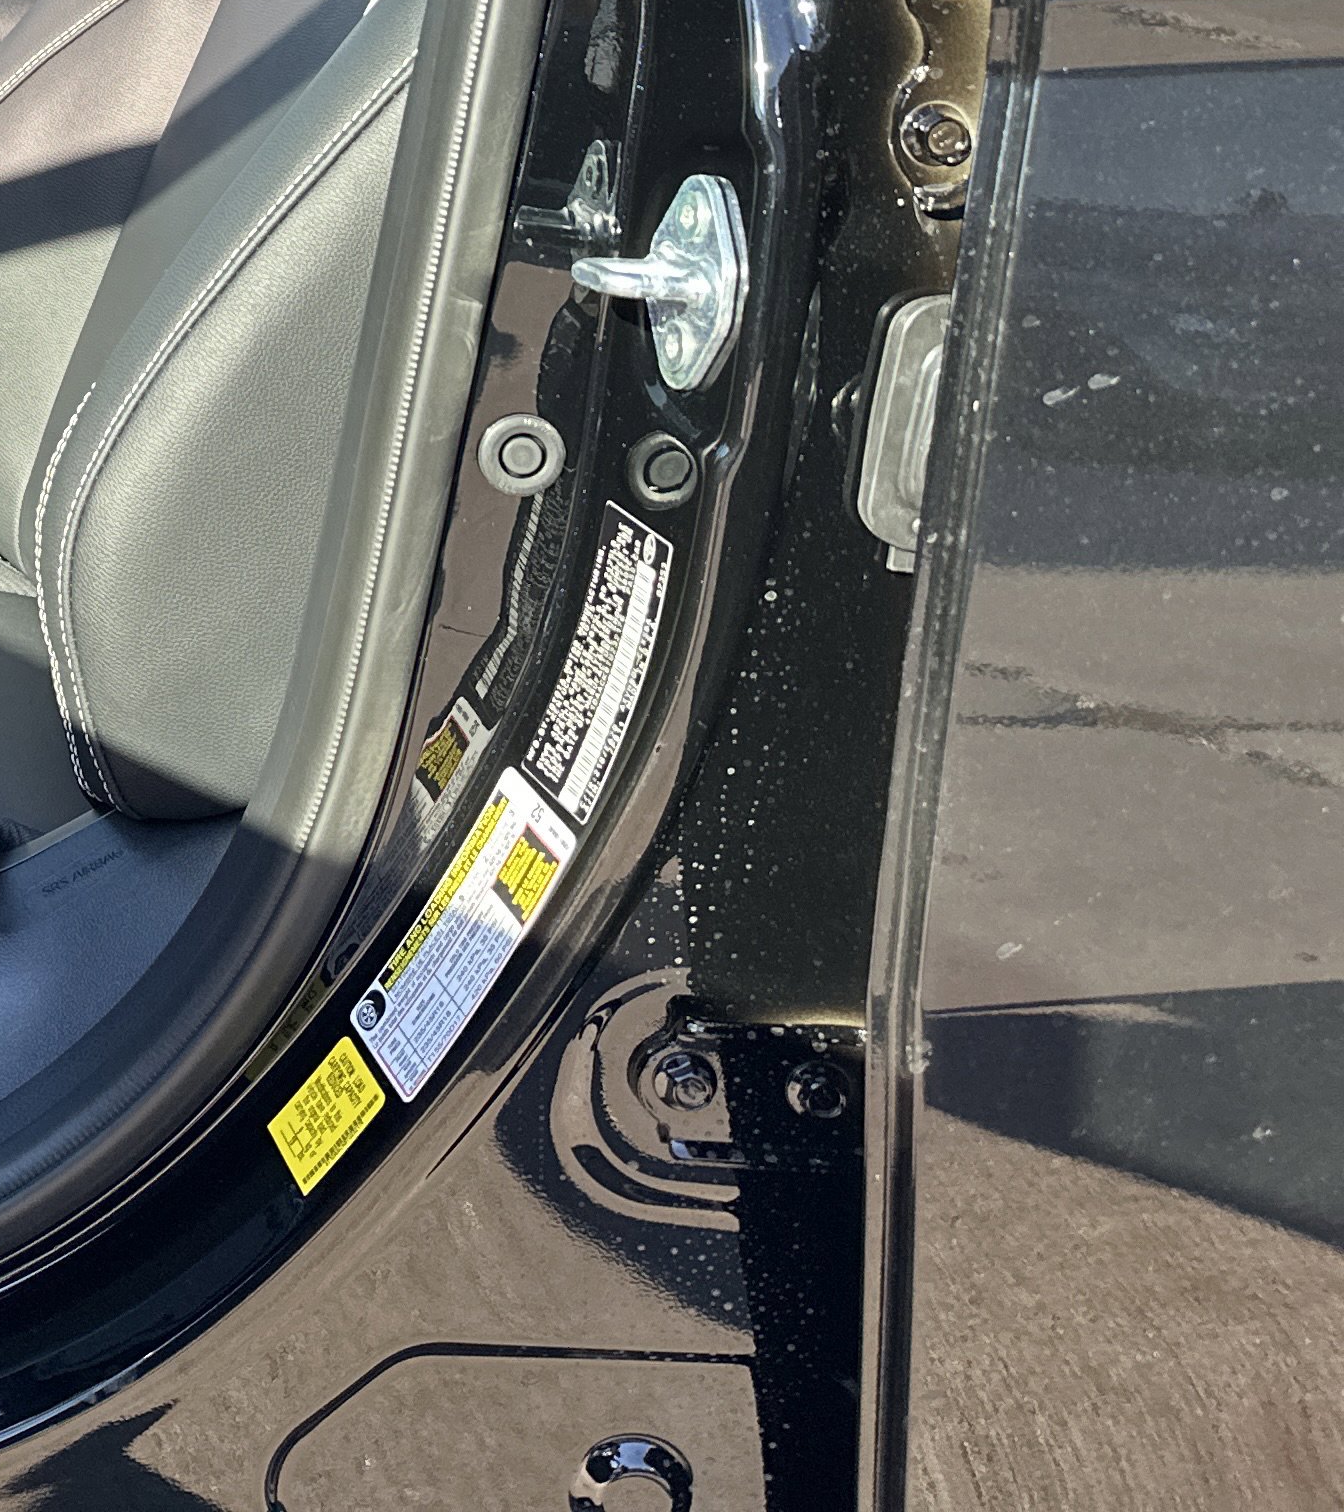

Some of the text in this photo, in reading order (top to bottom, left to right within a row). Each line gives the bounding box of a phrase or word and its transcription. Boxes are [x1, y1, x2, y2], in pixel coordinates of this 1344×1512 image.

[387, 944, 407, 971] TIRE
[404, 922, 423, 949] AND
[419, 875, 453, 925] LOADING
[449, 802, 497, 878] INFORMATION
